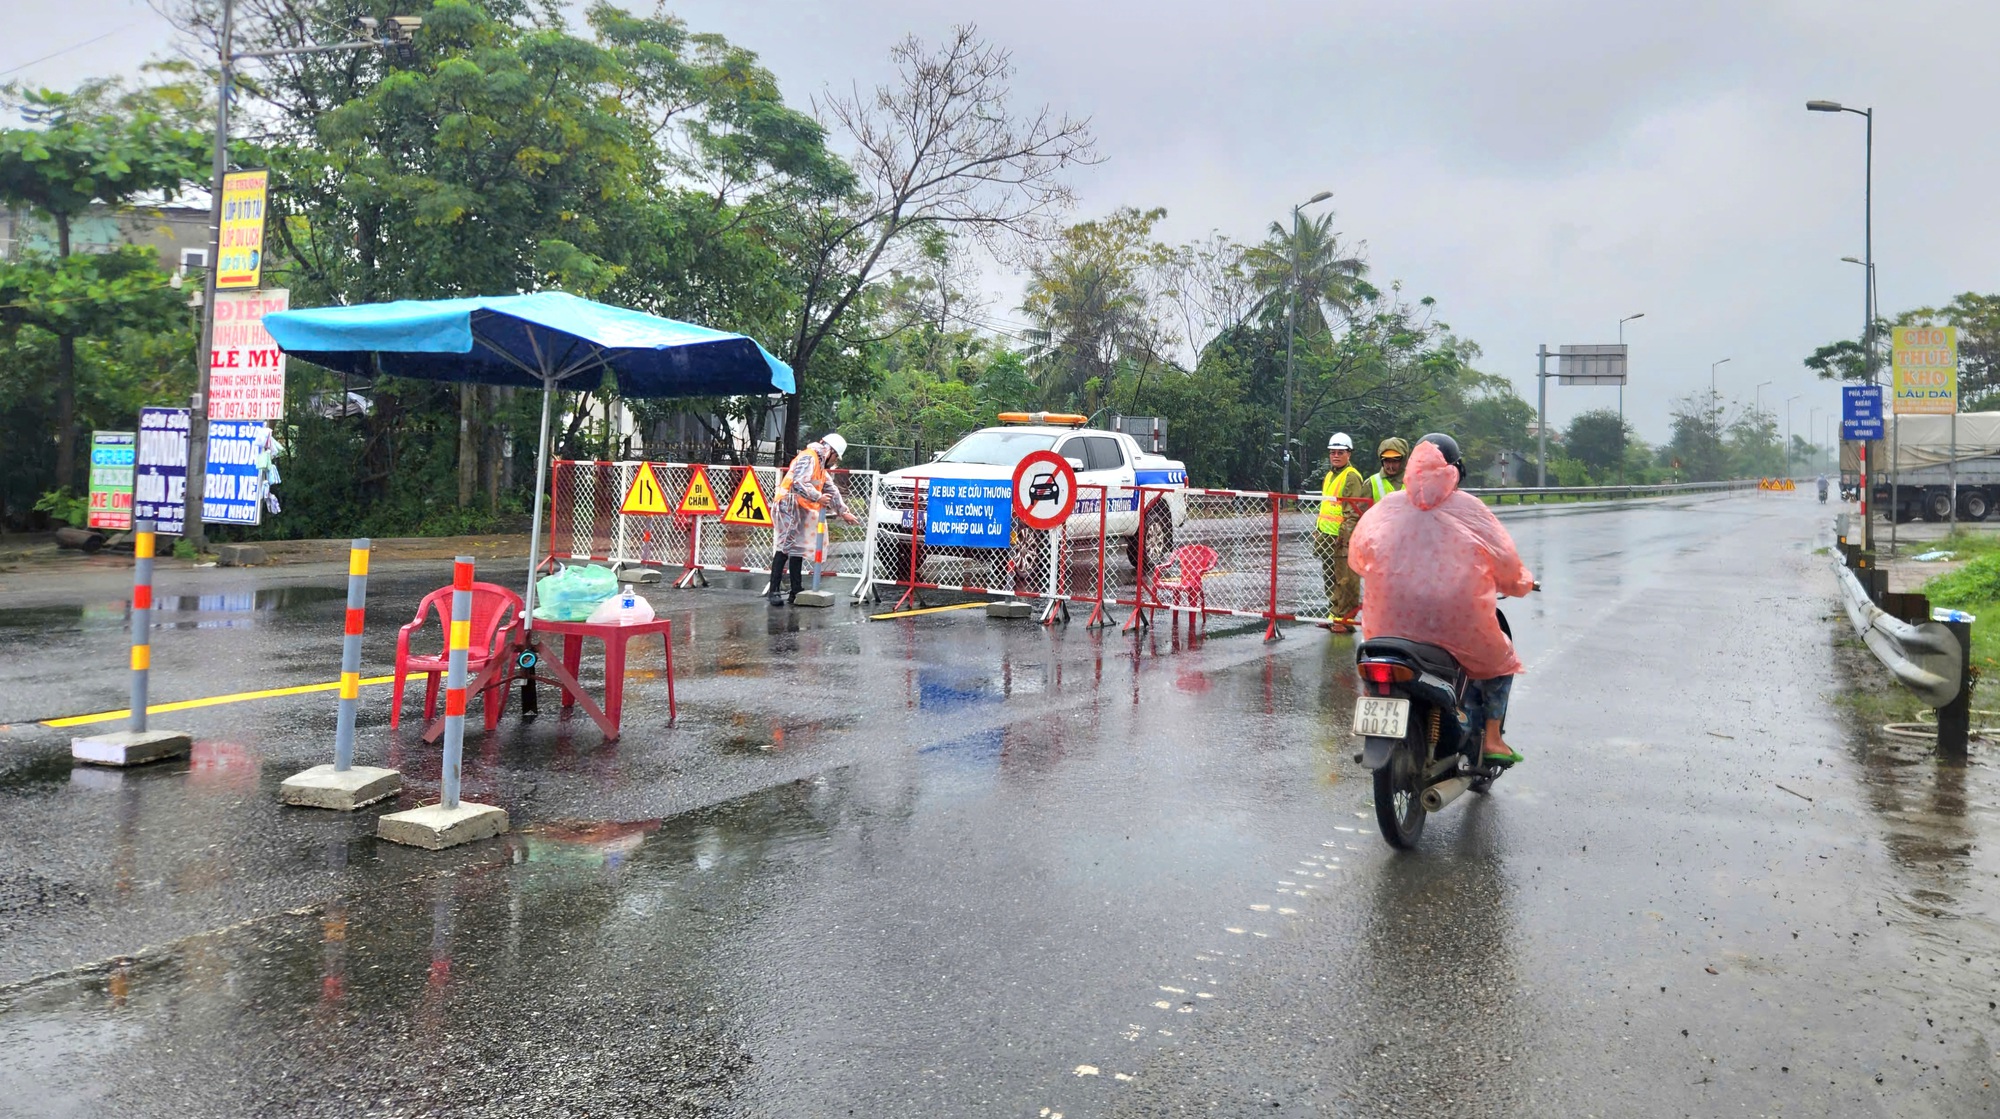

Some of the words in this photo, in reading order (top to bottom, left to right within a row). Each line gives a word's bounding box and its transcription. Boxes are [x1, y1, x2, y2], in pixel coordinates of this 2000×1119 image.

[1903, 329, 1945, 346] CHO
[210, 346, 240, 368] LÊ
[1896, 345, 1953, 366] THUÊ
[210, 375, 233, 386] TRUNG
[1903, 371, 1947, 387] KHO
[1897, 388, 1925, 398] LÂU
[224, 402, 245, 418] 0974
[247, 402, 262, 418] 391
[266, 402, 281, 418] 137
[138, 430, 187, 467] HONDA
[209, 438, 260, 465] HONDA
[93, 469, 133, 486] TAXI
[167, 475, 186, 503] XE
[237, 475, 258, 501] XE
[932, 486, 941, 497] XE
[942, 486, 955, 497] BUS
[958, 486, 967, 498] XE
[90, 492, 107, 508] XE
[112, 489, 133, 509] ÔM
[203, 503, 228, 517] THAY
[955, 504, 964, 516] XE
[964, 503, 983, 516] CÔNG
[984, 504, 994, 519] VỤ
[951, 518, 968, 534] PHÉP
[970, 525, 984, 534] QUA
[987, 518, 1002, 535] CẦU
[1361, 718, 1399, 734] 0023
